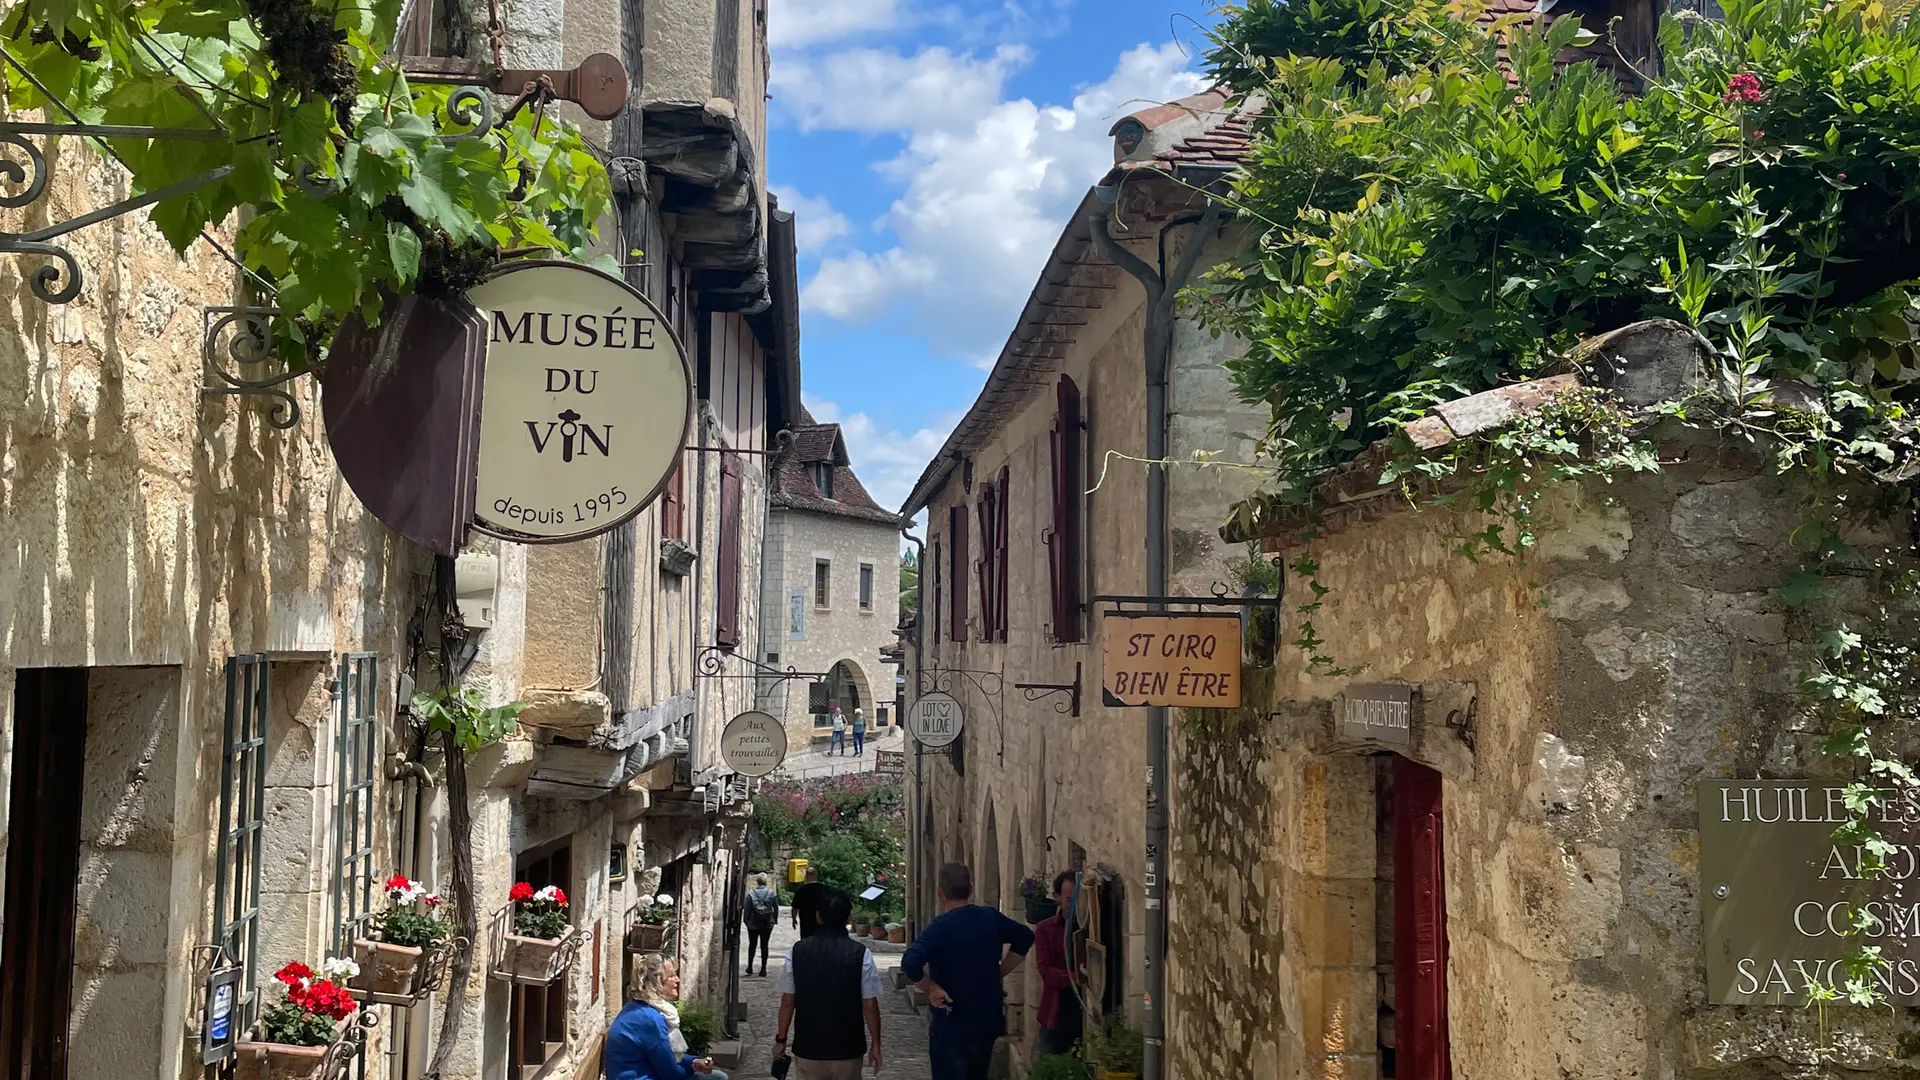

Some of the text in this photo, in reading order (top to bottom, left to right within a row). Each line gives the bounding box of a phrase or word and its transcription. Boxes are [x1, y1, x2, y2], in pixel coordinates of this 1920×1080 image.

[491, 306, 656, 350] MUSÉE
[545, 368, 600, 394] DU
[523, 410, 614, 463] VIN
[493, 486, 627, 525] depuis 1995
[1127, 633, 1216, 660] ST CIRQ
[1115, 666, 1231, 698] BIEN ÊTRE
[922, 702, 936, 717] LOT
[1370, 699, 1388, 726] BIEN
[1388, 694, 1408, 729] ÊTRE
[744, 720, 767, 732] Aux
[922, 719, 950, 733] IN LOVE
[730, 747, 779, 758] trouvailles
[739, 735, 771, 747] petites
[1720, 787, 1869, 823] HUILE
